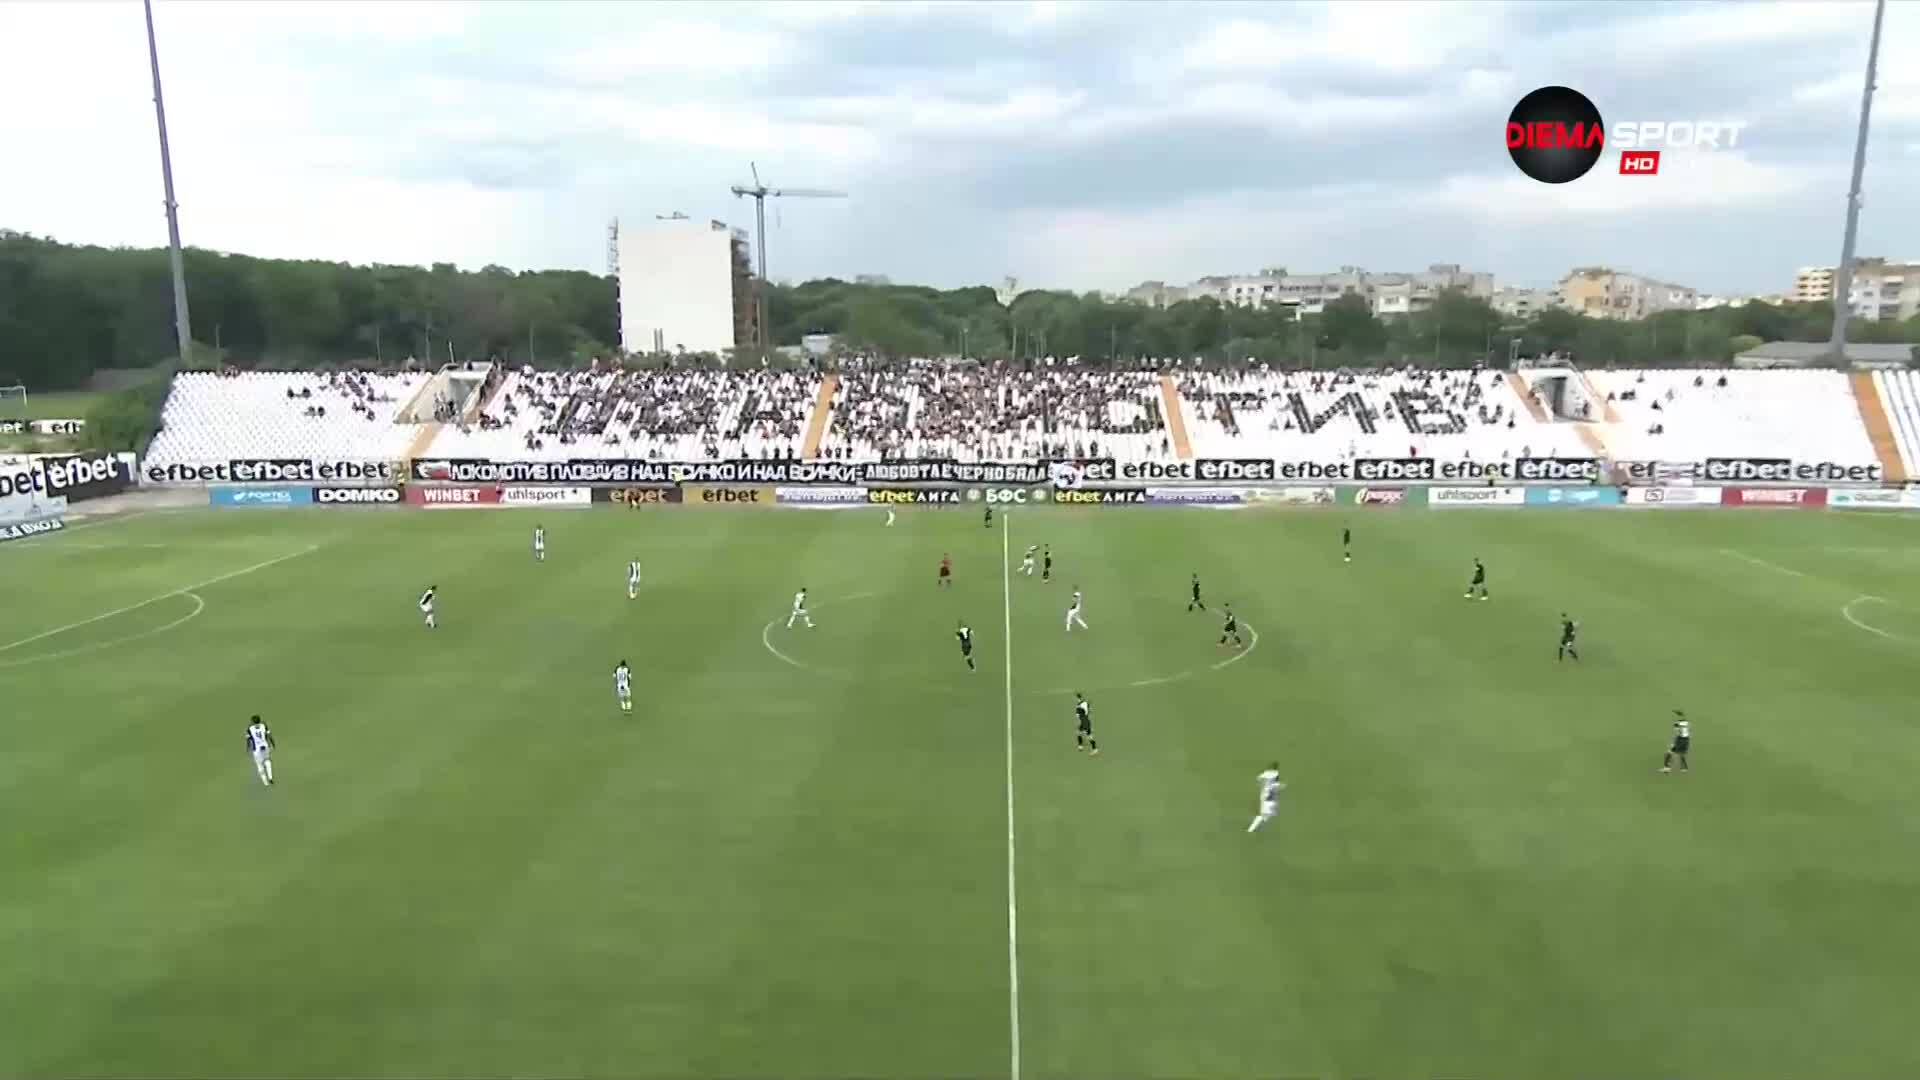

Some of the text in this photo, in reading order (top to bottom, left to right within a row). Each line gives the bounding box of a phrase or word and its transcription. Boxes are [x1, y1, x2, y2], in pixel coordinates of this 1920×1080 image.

[48, 453, 118, 489] efbet
[150, 464, 228, 481] efbet
[236, 461, 311, 480] efbet
[318, 461, 390, 480] efbet
[452, 464, 548, 480] ЛОКОМОТИВ
[551, 464, 628, 480] ПЛОВДИВ
[631, 464, 665, 480] НАД
[738, 464, 751, 480] И
[753, 464, 787, 480] НАД
[1123, 462, 1191, 478] efbet
[1202, 461, 1272, 478] efbet
[1282, 462, 1350, 478] efbet
[1359, 461, 1432, 478] efbet
[1442, 461, 1511, 478] efbet
[1521, 460, 1596, 478] efbet
[1709, 461, 1790, 479] efbet
[1797, 462, 1880, 480] efbet
[319, 488, 399, 502] DOMKO
[424, 489, 480, 502] WINBET
[508, 487, 565, 501] uhlsport
[703, 488, 759, 502] efbet
[986, 488, 1027, 503] БФС
